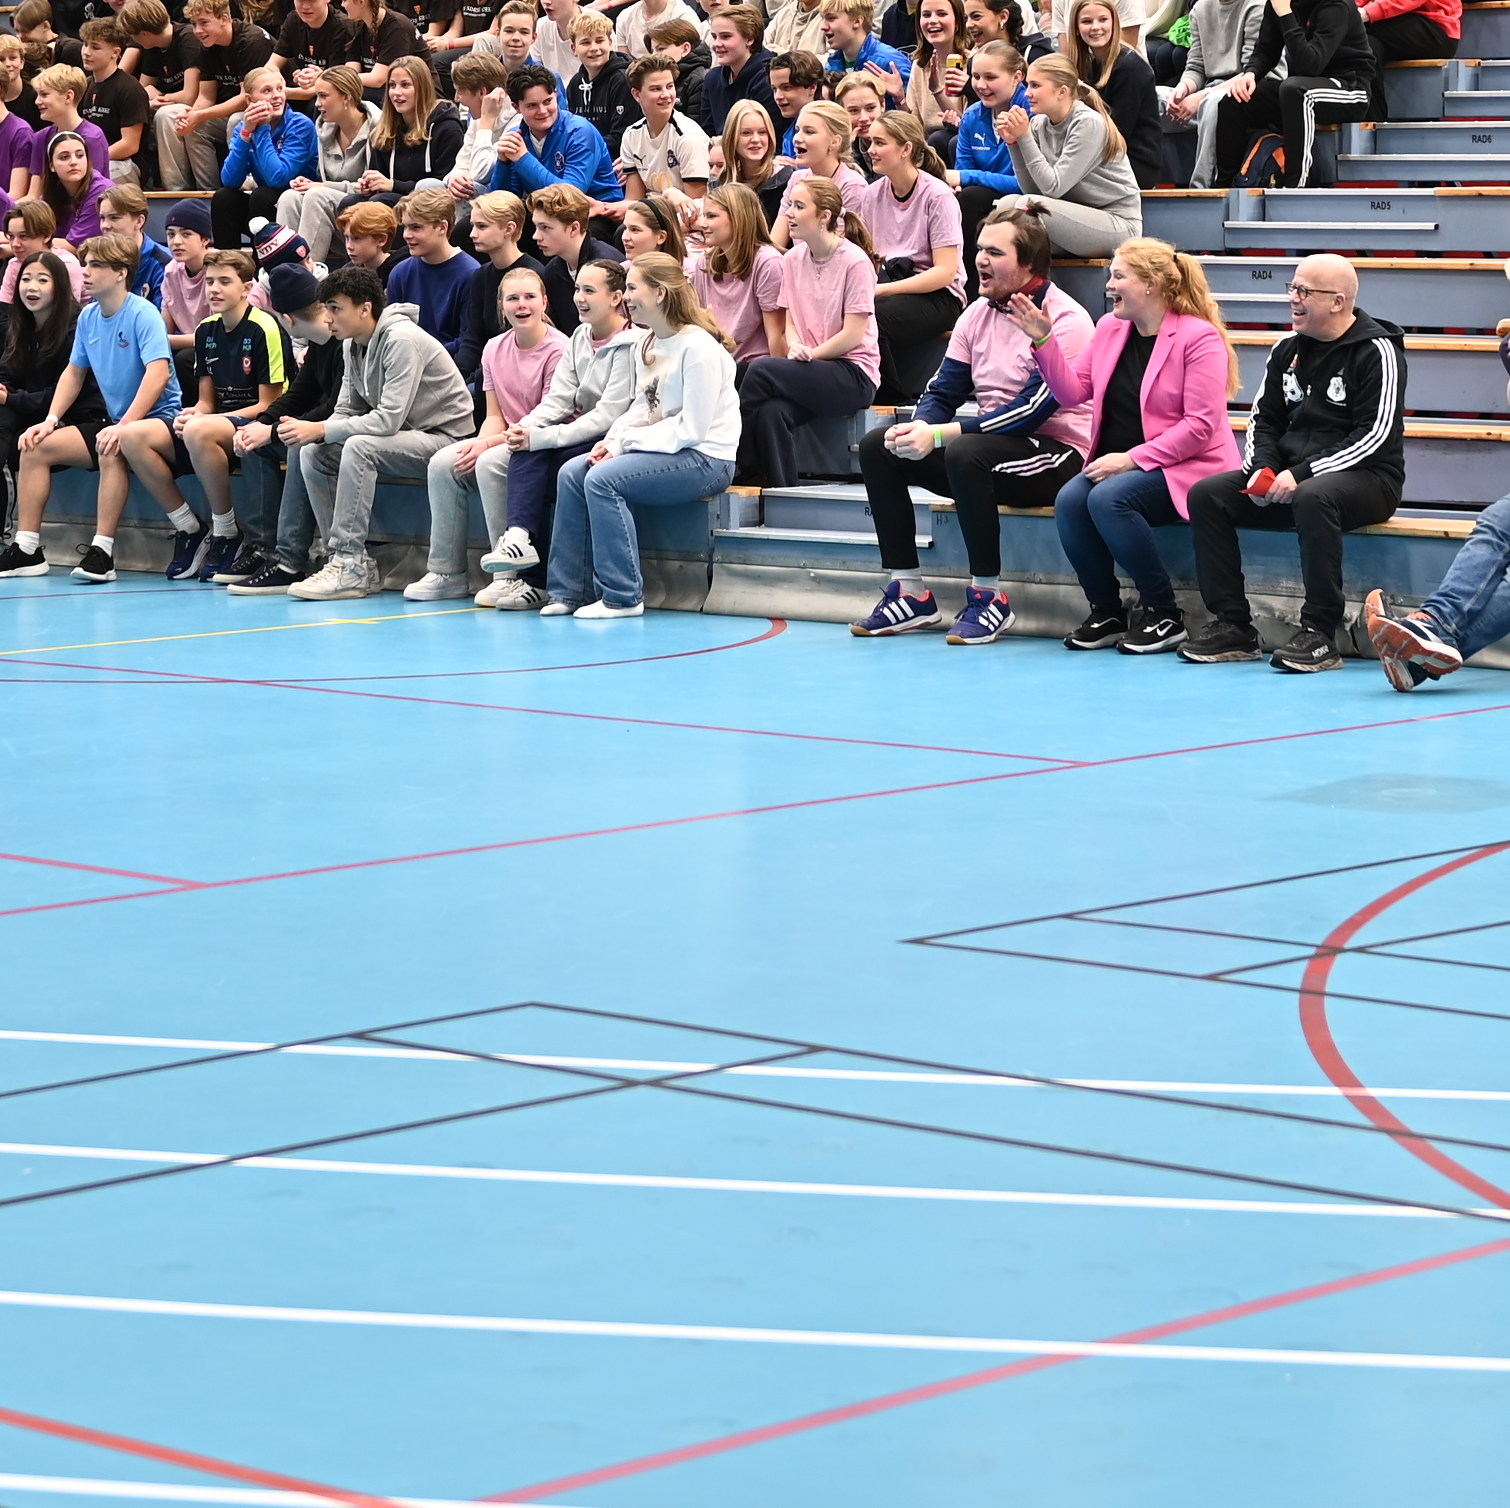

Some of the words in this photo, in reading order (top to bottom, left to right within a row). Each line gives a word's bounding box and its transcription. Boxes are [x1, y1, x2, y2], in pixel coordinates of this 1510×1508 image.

[1471, 134, 1492, 144] RAD6
[1370, 201, 1392, 211] RAD5
[1251, 270, 1273, 280] RAD4
